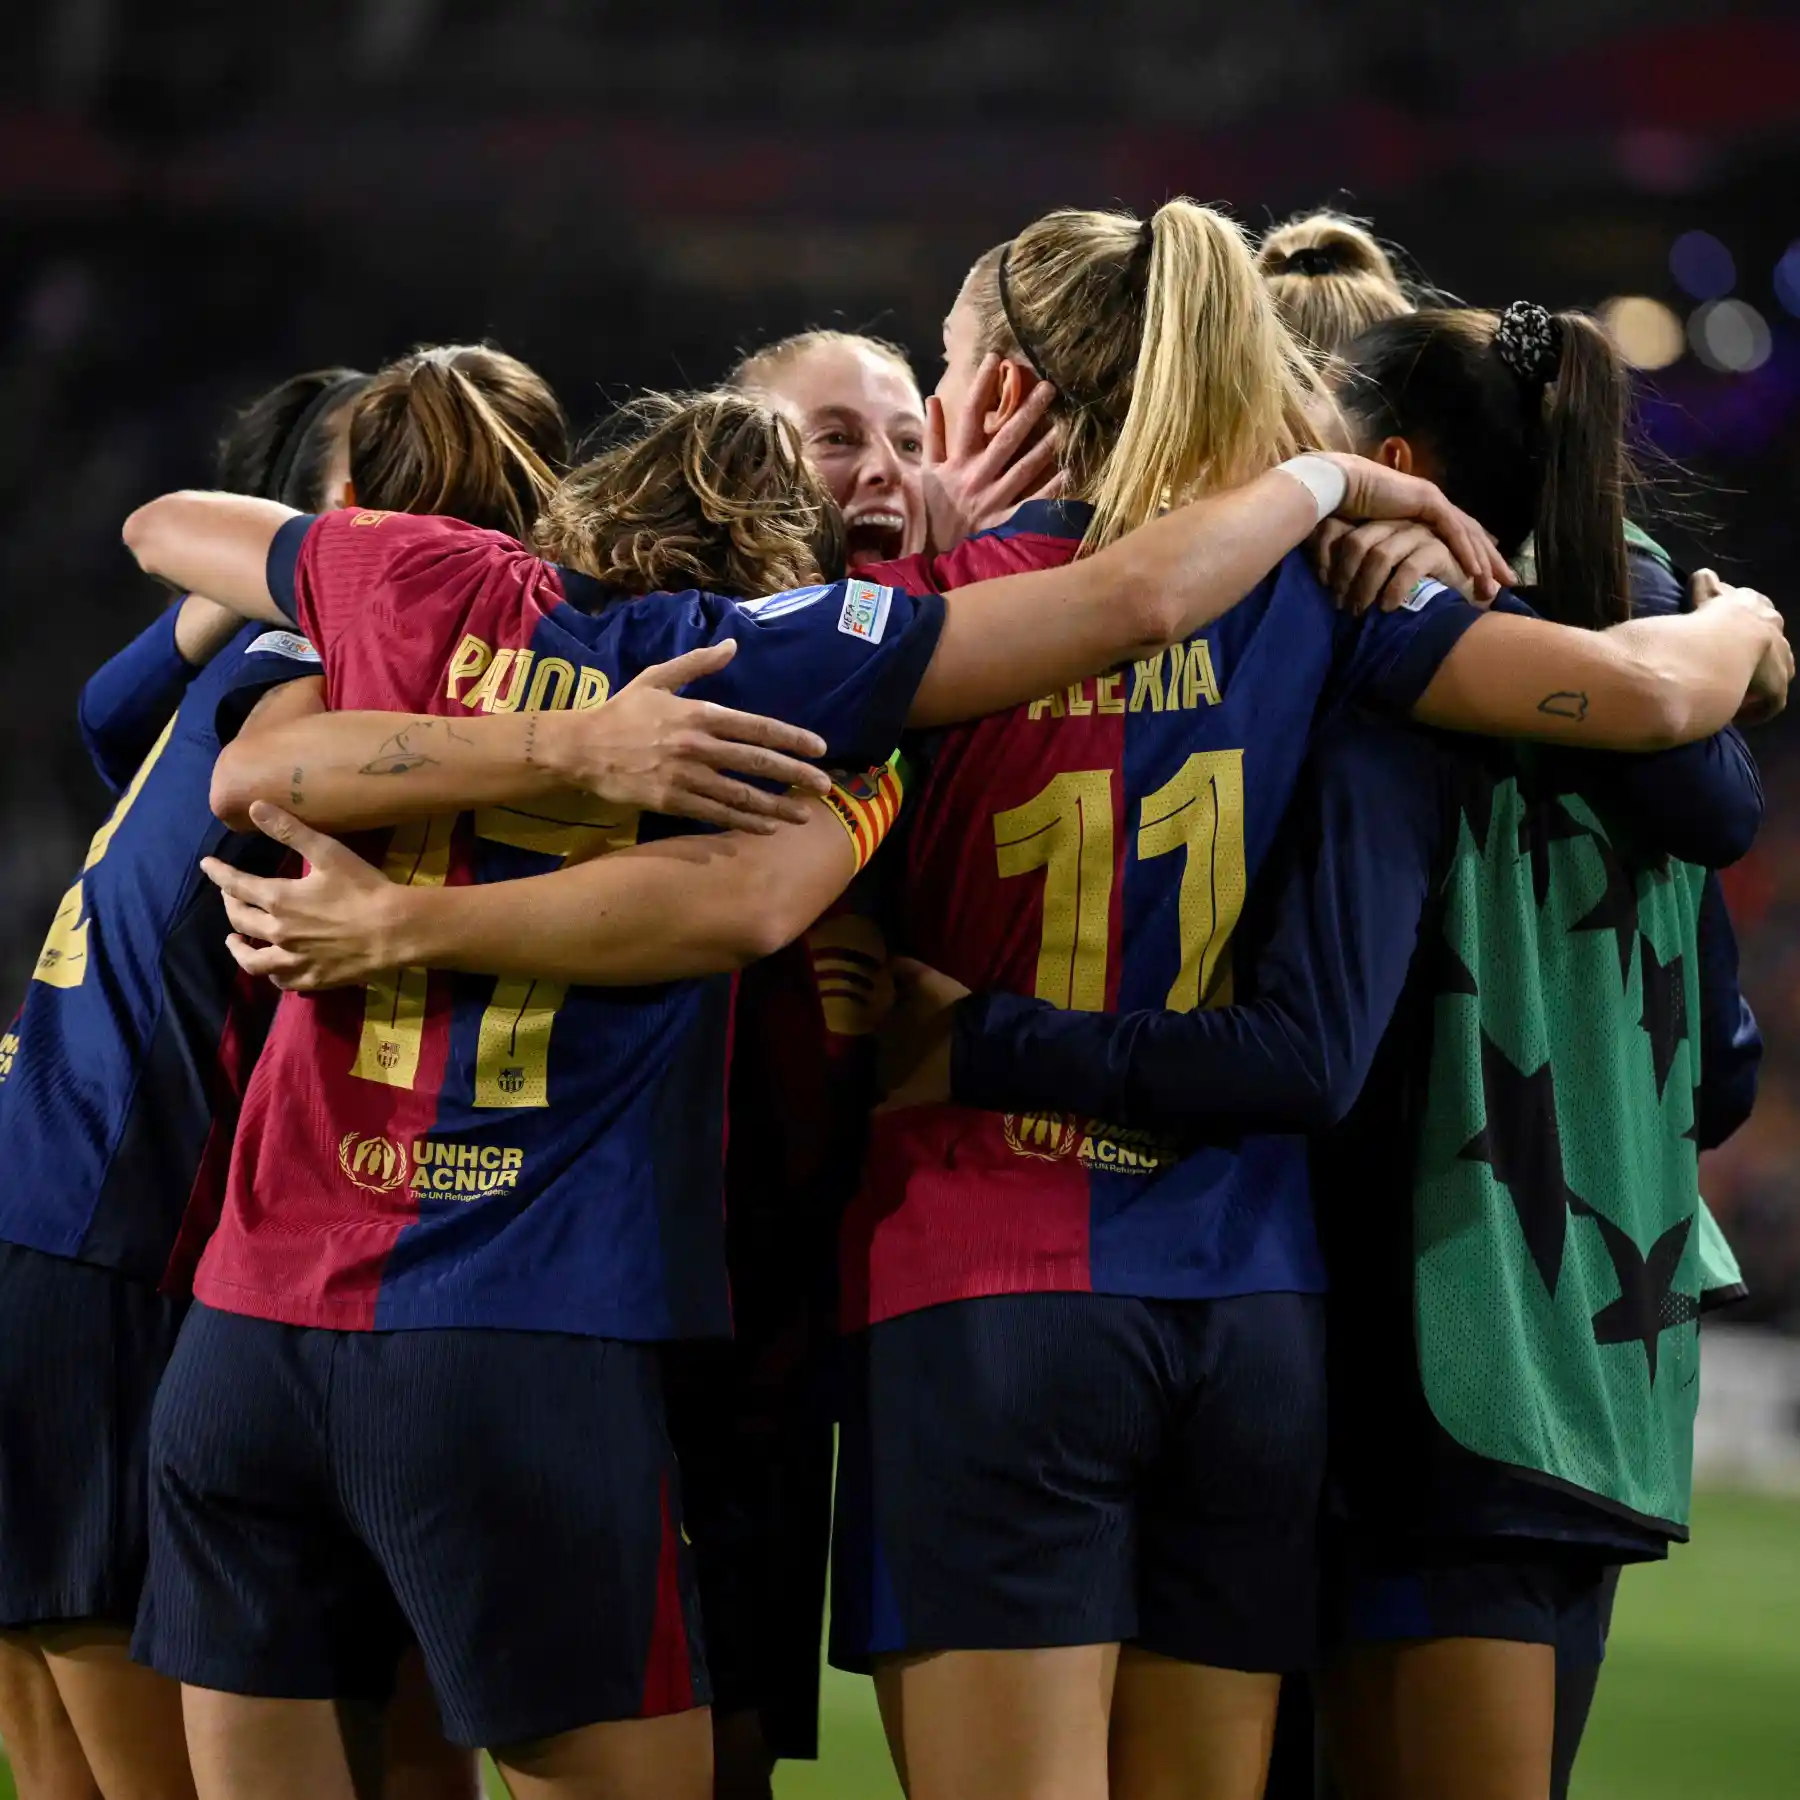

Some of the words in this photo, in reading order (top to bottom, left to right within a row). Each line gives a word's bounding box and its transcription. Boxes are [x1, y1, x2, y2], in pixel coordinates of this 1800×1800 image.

[841, 604, 855, 630] UEFA
[993, 749, 1246, 1014] 11
[412, 1140, 524, 1170] UNHCR
[1077, 1136, 1166, 1168] ACNU
[409, 1166, 519, 1191] ACNUR
[410, 1190, 427, 1199] The
[429, 1191, 443, 1200] UN
[445, 1192, 481, 1203] Refugee
[482, 1188, 511, 1197] Agenc
